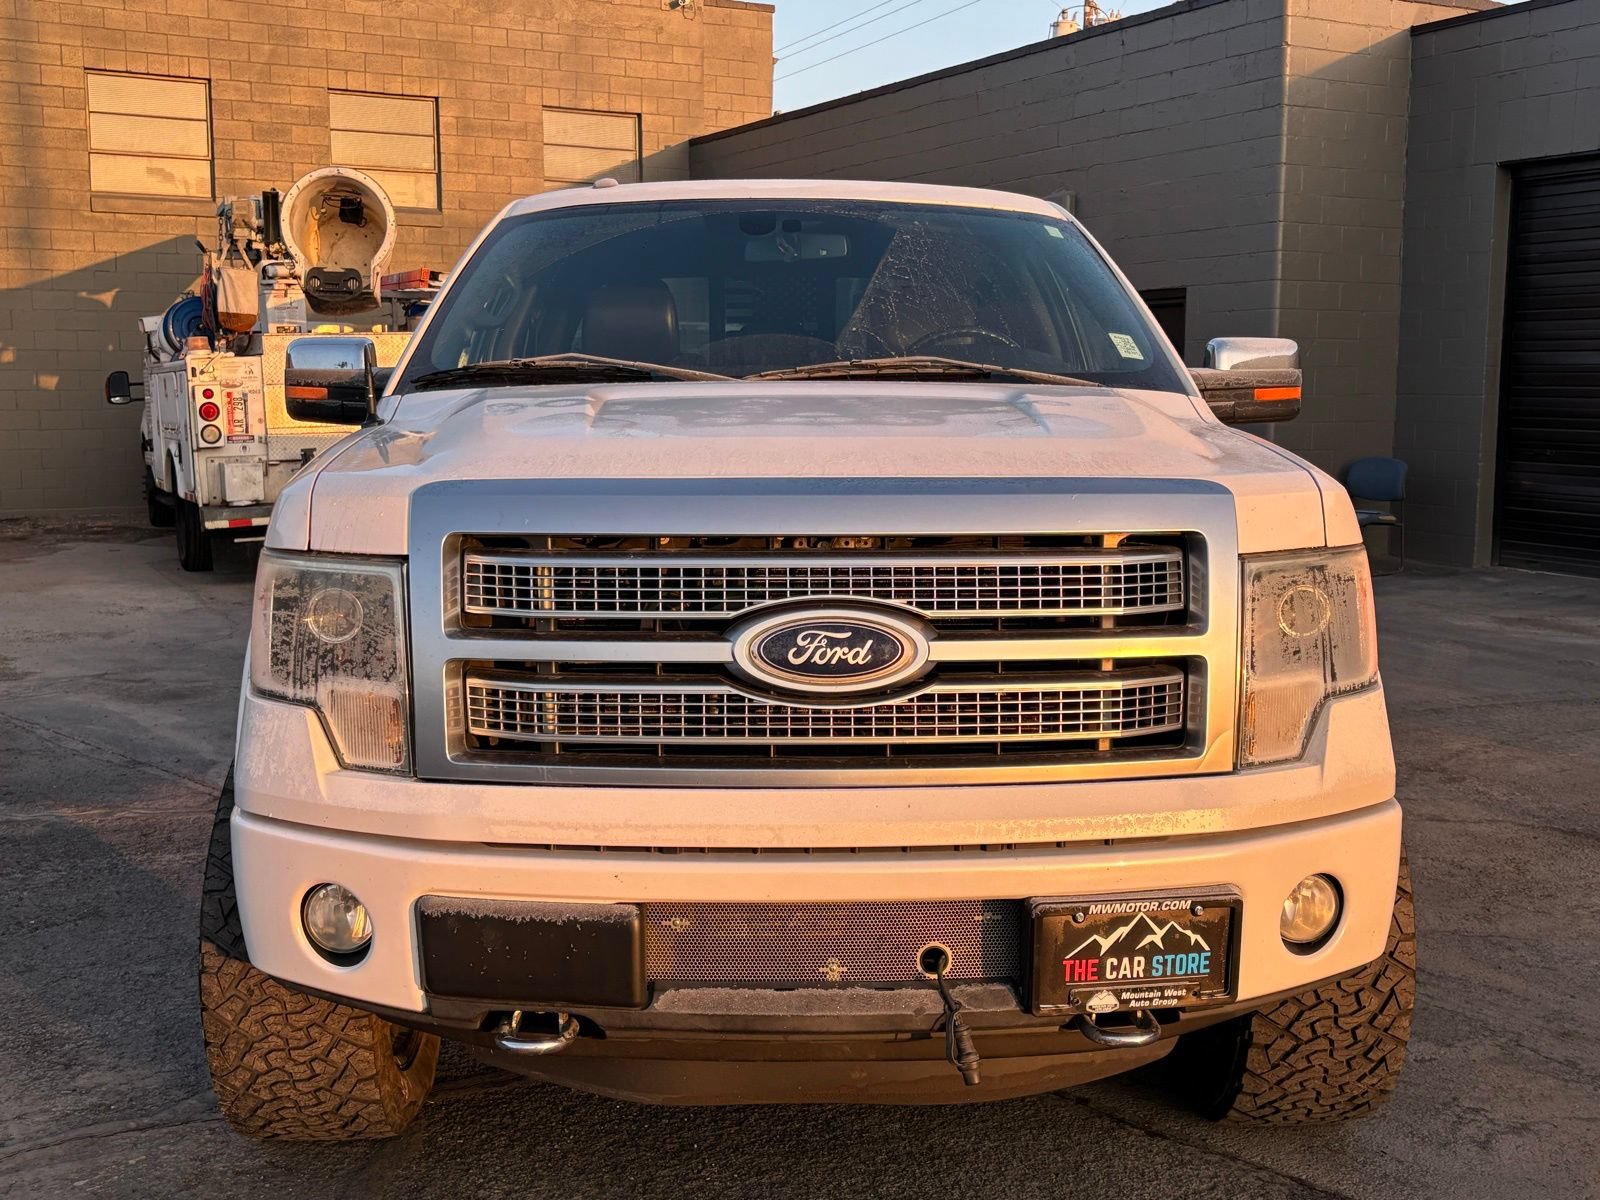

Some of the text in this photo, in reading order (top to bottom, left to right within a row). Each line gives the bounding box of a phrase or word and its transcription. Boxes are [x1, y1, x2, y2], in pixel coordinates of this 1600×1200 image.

[232, 397, 243, 411] 298
[788, 630, 873, 665] Ford
[1088, 900, 1192, 915] MWMOTOR.COM
[1062, 952, 1211, 982] THE CAR STORE
[1121, 988, 1187, 1000] Mountain West
[1129, 998, 1178, 1008] Auto Group
